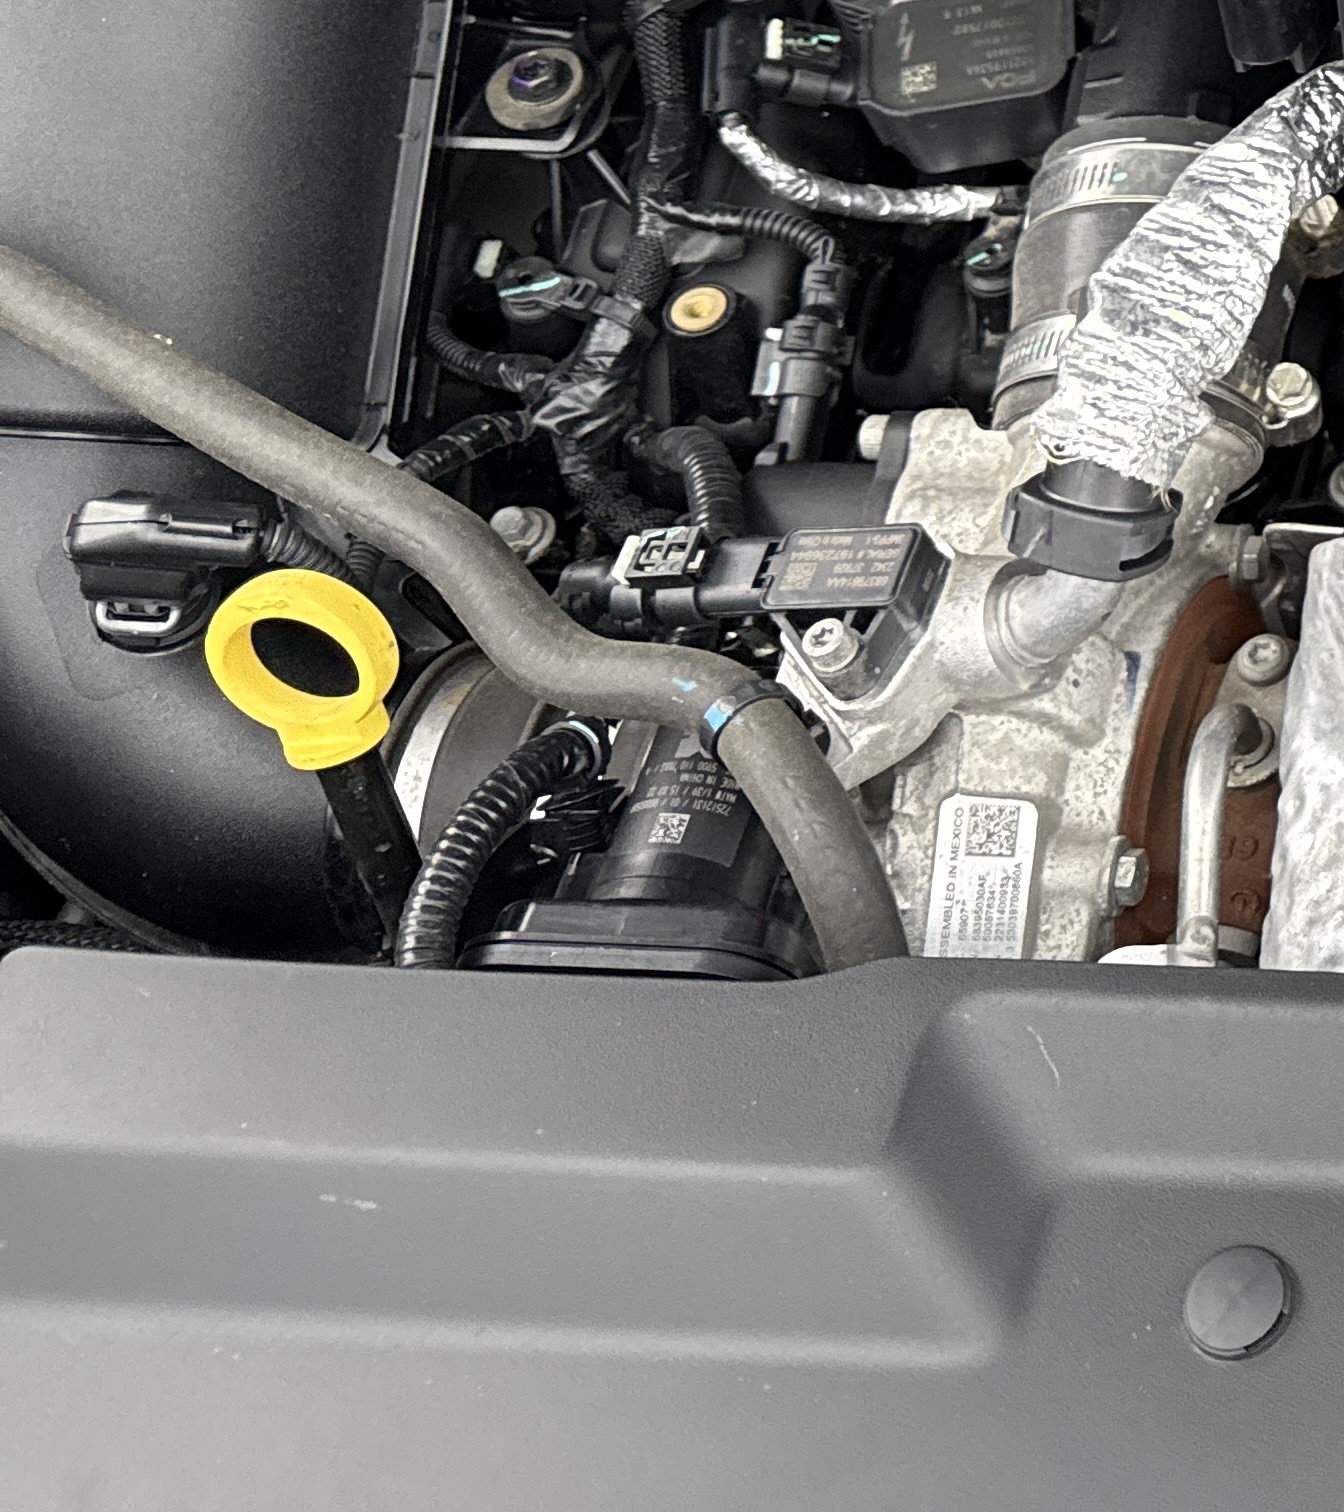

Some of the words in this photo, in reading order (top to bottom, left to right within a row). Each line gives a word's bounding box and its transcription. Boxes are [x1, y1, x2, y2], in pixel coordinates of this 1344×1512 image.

[950, 807, 964, 861] MEXICO
[949, 865, 957, 879] IN
[939, 883, 955, 958] SSEMBLED
